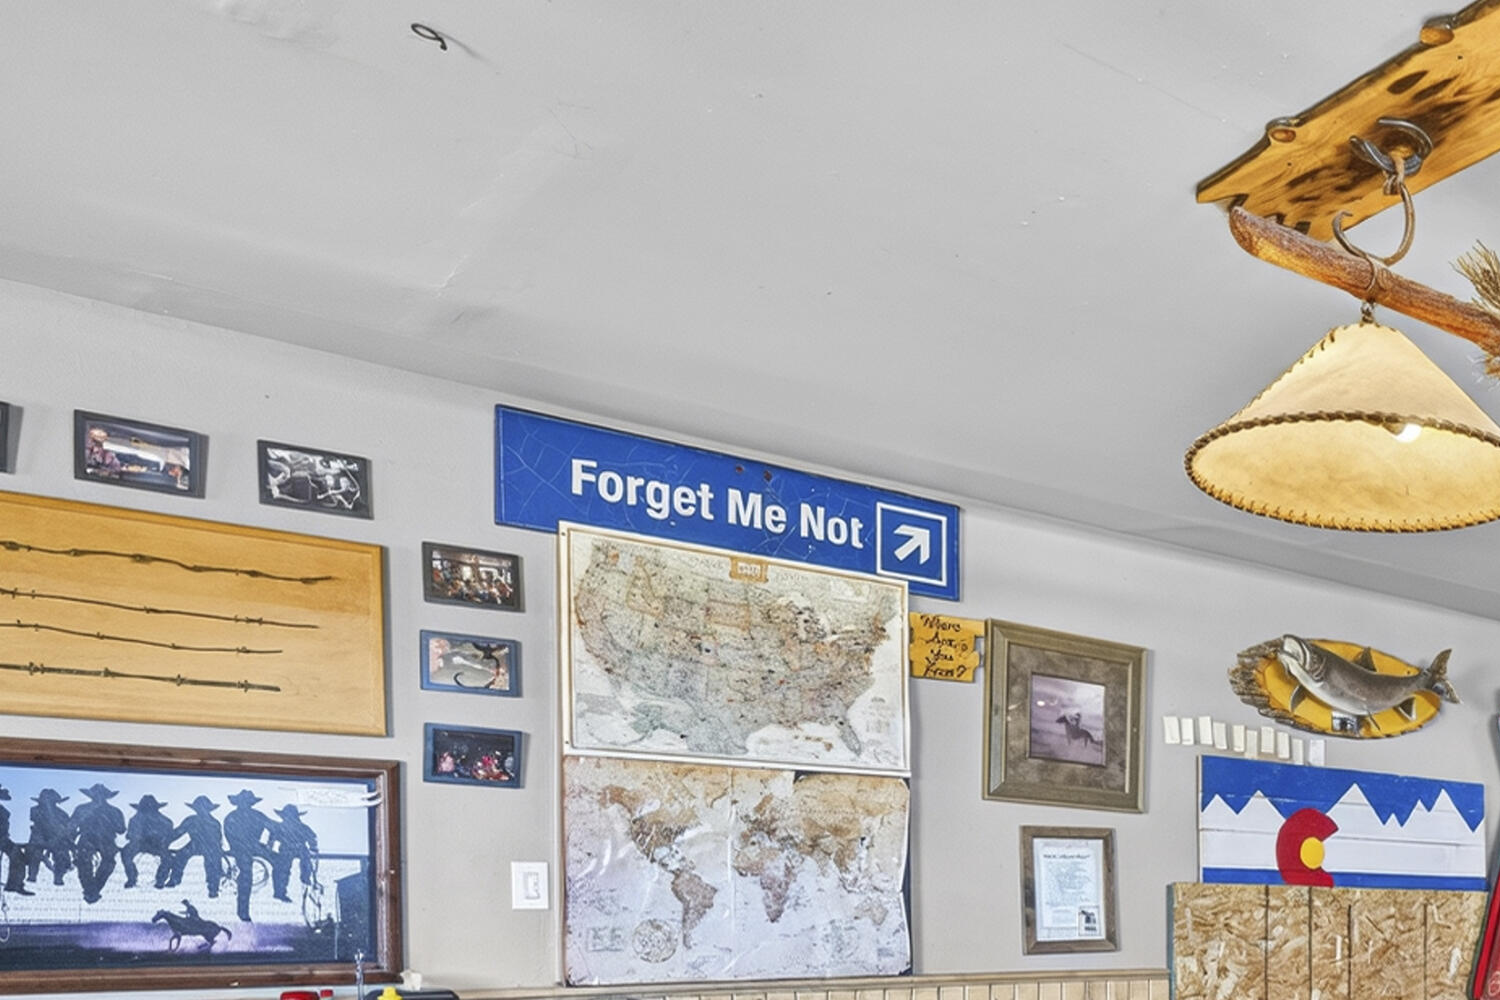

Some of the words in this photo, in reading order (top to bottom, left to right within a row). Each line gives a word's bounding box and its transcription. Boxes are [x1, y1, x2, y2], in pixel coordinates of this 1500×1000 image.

[570, 458, 714, 520] Forget
[727, 488, 787, 534] Me
[800, 502, 864, 549] Not
